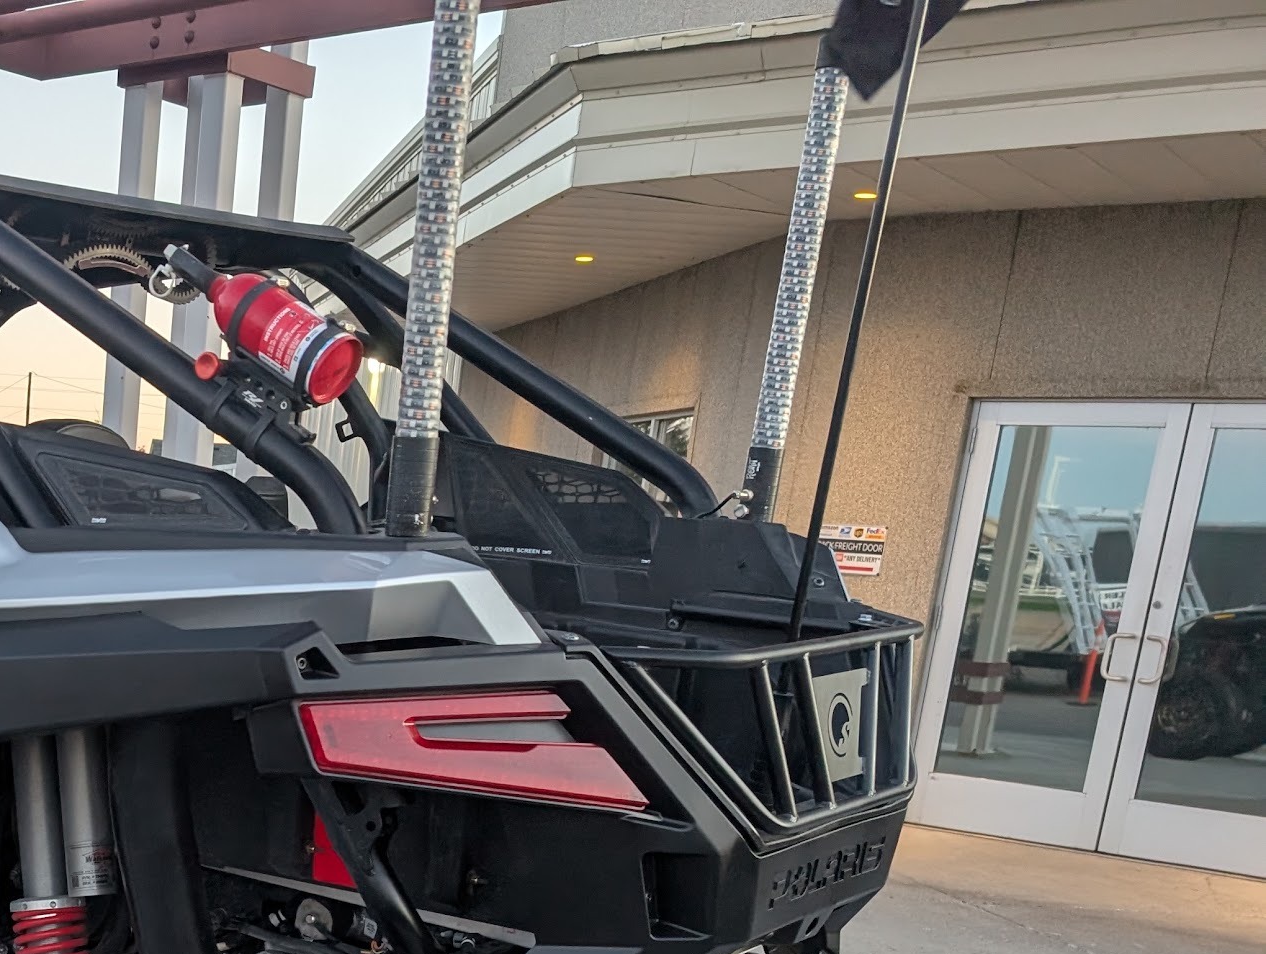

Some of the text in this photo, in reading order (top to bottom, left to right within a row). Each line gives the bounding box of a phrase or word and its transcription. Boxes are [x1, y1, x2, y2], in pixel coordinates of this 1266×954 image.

[834, 541, 863, 551] FREIGHT
[862, 543, 883, 553] DOOR
[767, 837, 886, 912] POLARIS
